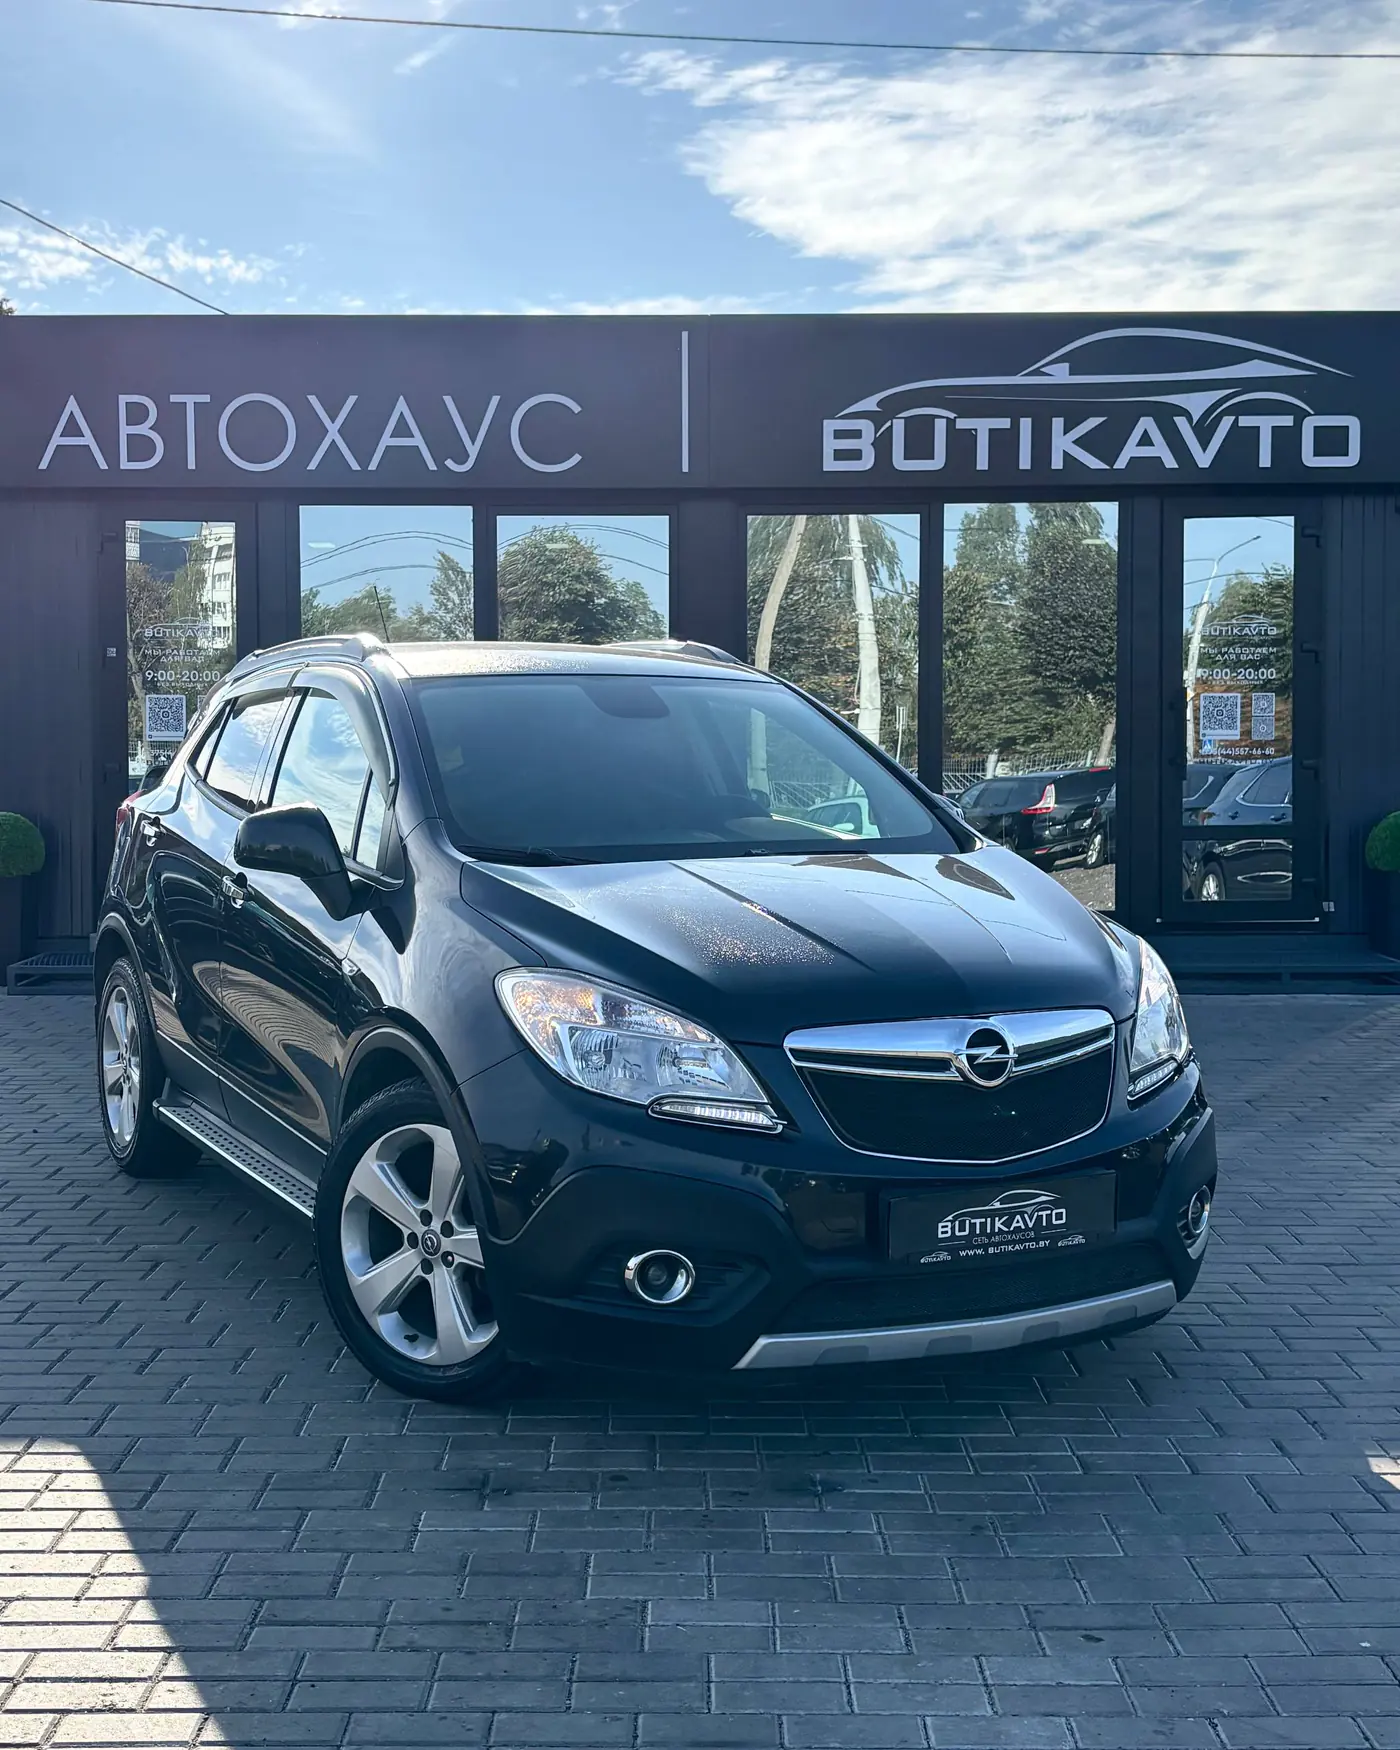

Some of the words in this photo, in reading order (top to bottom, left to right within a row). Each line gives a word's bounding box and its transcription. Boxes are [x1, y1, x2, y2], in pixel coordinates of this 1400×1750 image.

[38, 393, 583, 473] АВТОХАУС
[822, 415, 1361, 471] BUTIKAVTO
[144, 627, 219, 637] BUTIKAV
[1201, 626, 1277, 635] BUTIKAVTO
[145, 670, 220, 681] 9:00-20:00
[937, 1208, 1066, 1239] BUTIKAVTO
[972, 1236, 989, 1245] СЕТЬ
[959, 1249, 985, 1257] WWW.
